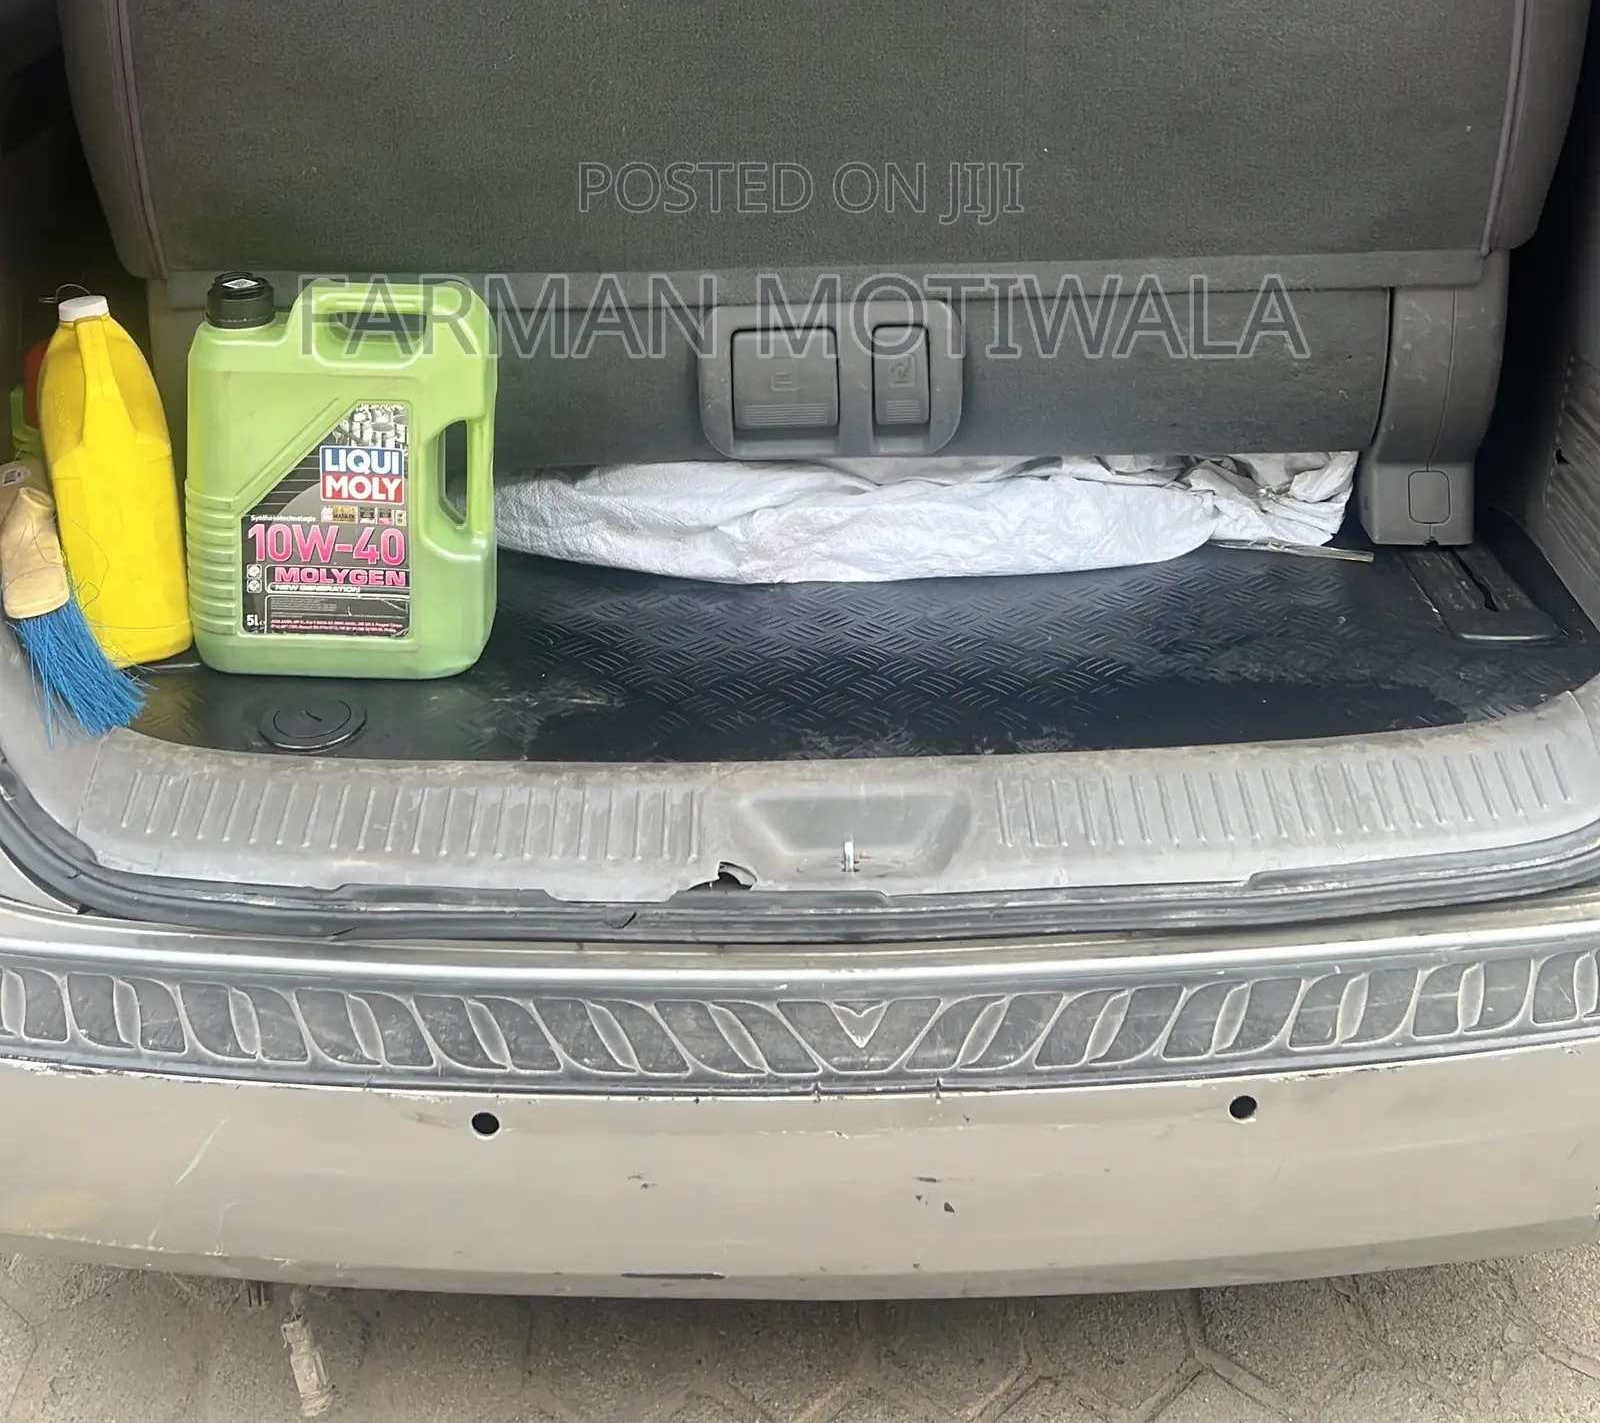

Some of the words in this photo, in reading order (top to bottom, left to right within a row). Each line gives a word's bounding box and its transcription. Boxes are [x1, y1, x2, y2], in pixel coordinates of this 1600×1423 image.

[325, 448, 400, 475] LIQUI
[325, 475, 401, 501] MOLY
[248, 523, 405, 566] 10W-40
[274, 566, 406, 587] MOLYGEN
[299, 584, 361, 593] GENERATION
